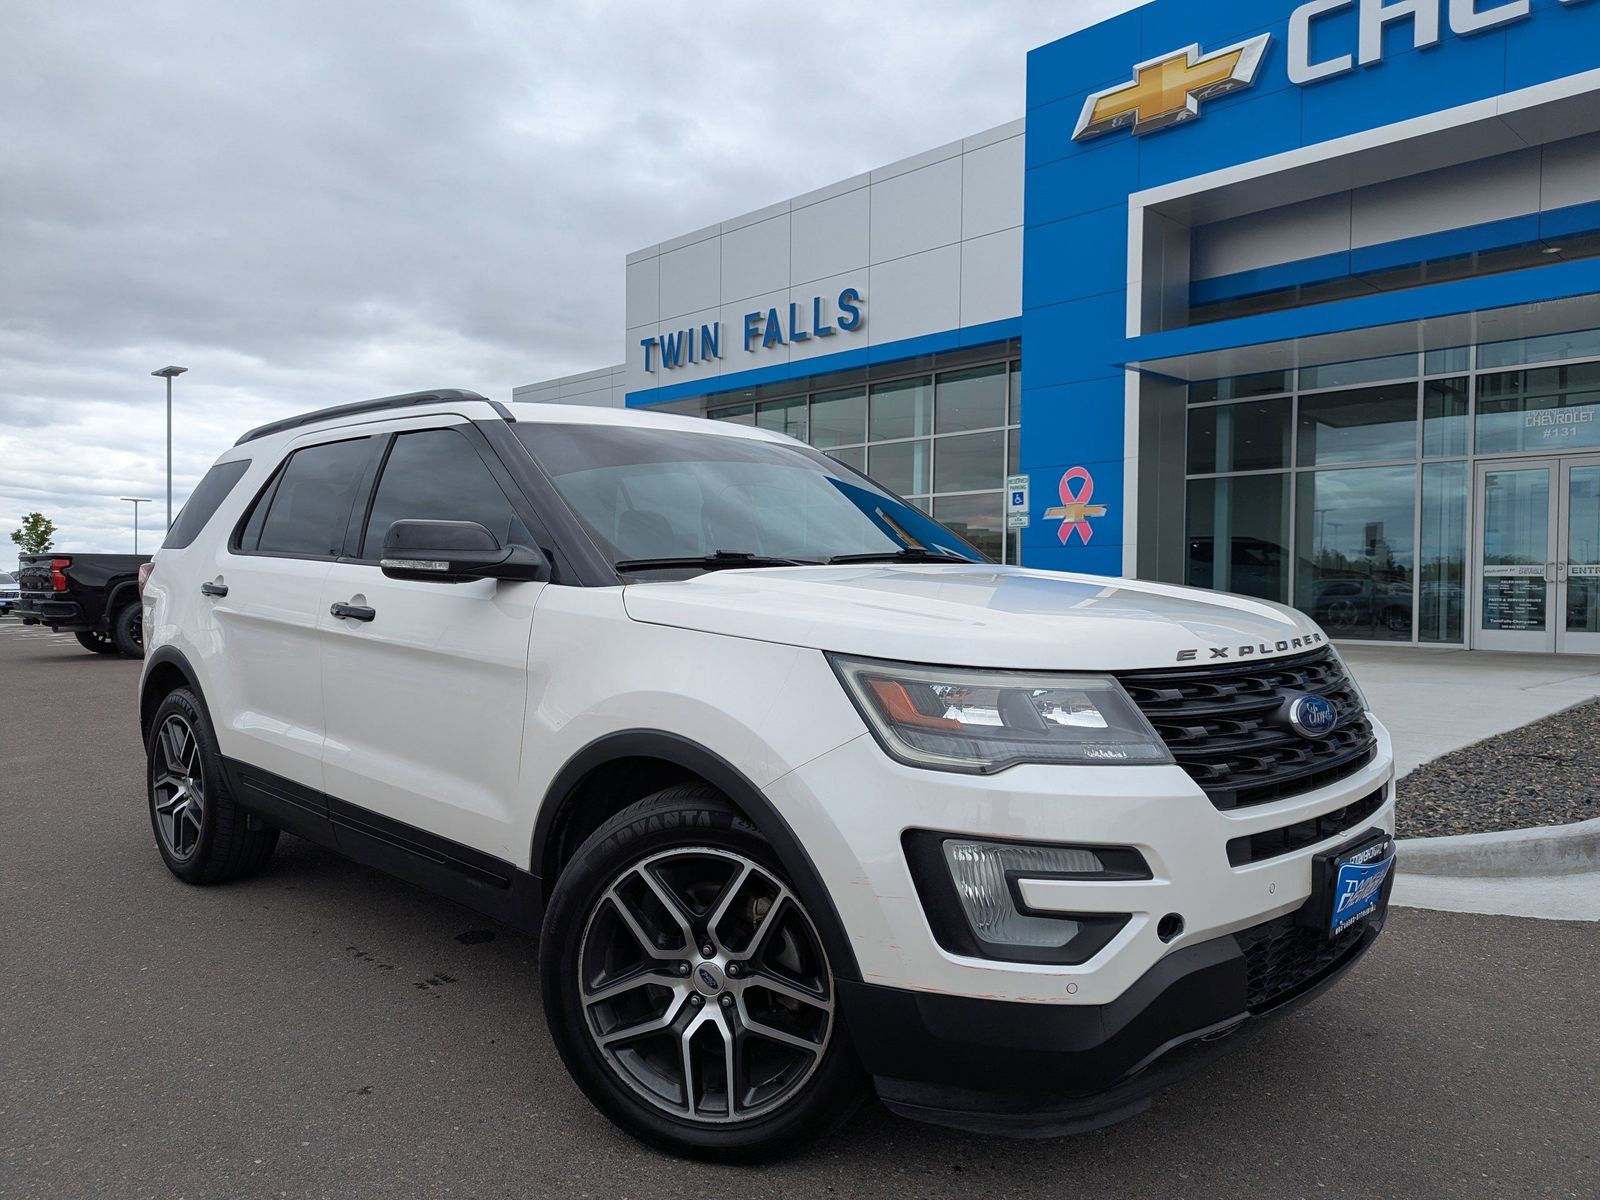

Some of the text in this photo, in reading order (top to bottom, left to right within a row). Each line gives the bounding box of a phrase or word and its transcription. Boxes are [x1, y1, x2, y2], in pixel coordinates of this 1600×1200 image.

[640, 288, 863, 373] TWIN FALLS
[1526, 411, 1595, 427] CHEVROLET
[1543, 426, 1577, 439] #131
[1176, 633, 1322, 661] EXPLORER
[1306, 703, 1333, 724] Ford
[601, 811, 712, 850] ADVANTA
